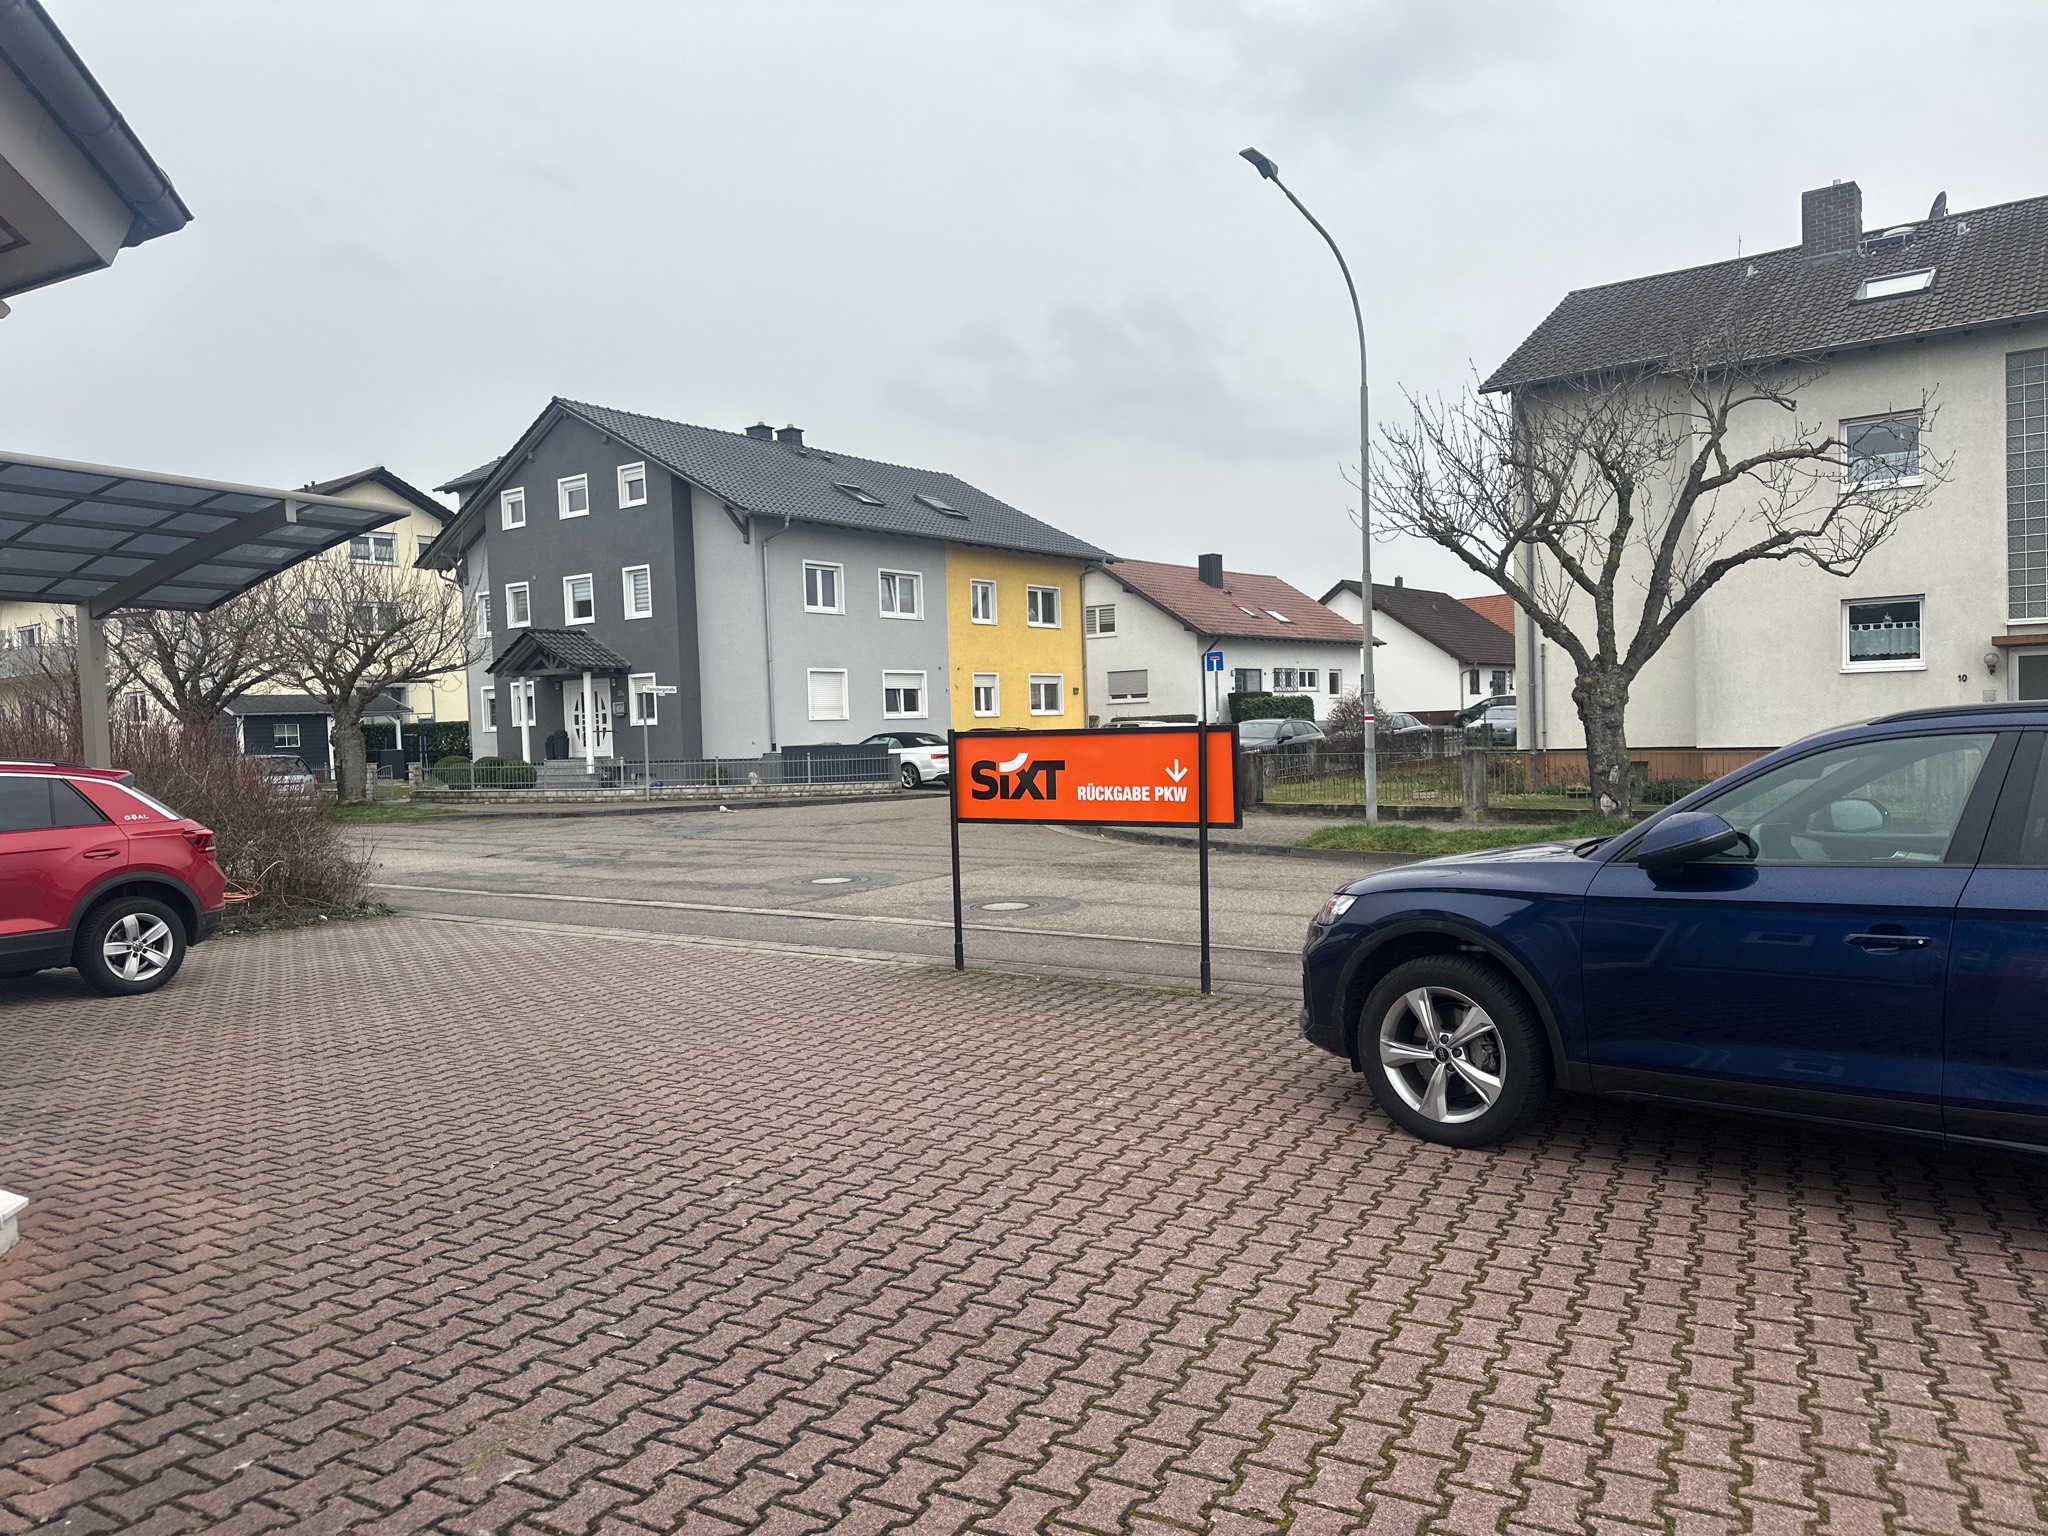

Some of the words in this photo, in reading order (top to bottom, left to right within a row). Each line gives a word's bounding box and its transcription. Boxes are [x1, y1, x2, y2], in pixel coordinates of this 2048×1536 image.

[1957, 674, 1968, 682] 10
[1077, 783, 1150, 802] RÜCKGABE
[1154, 786, 1188, 802] PKW
